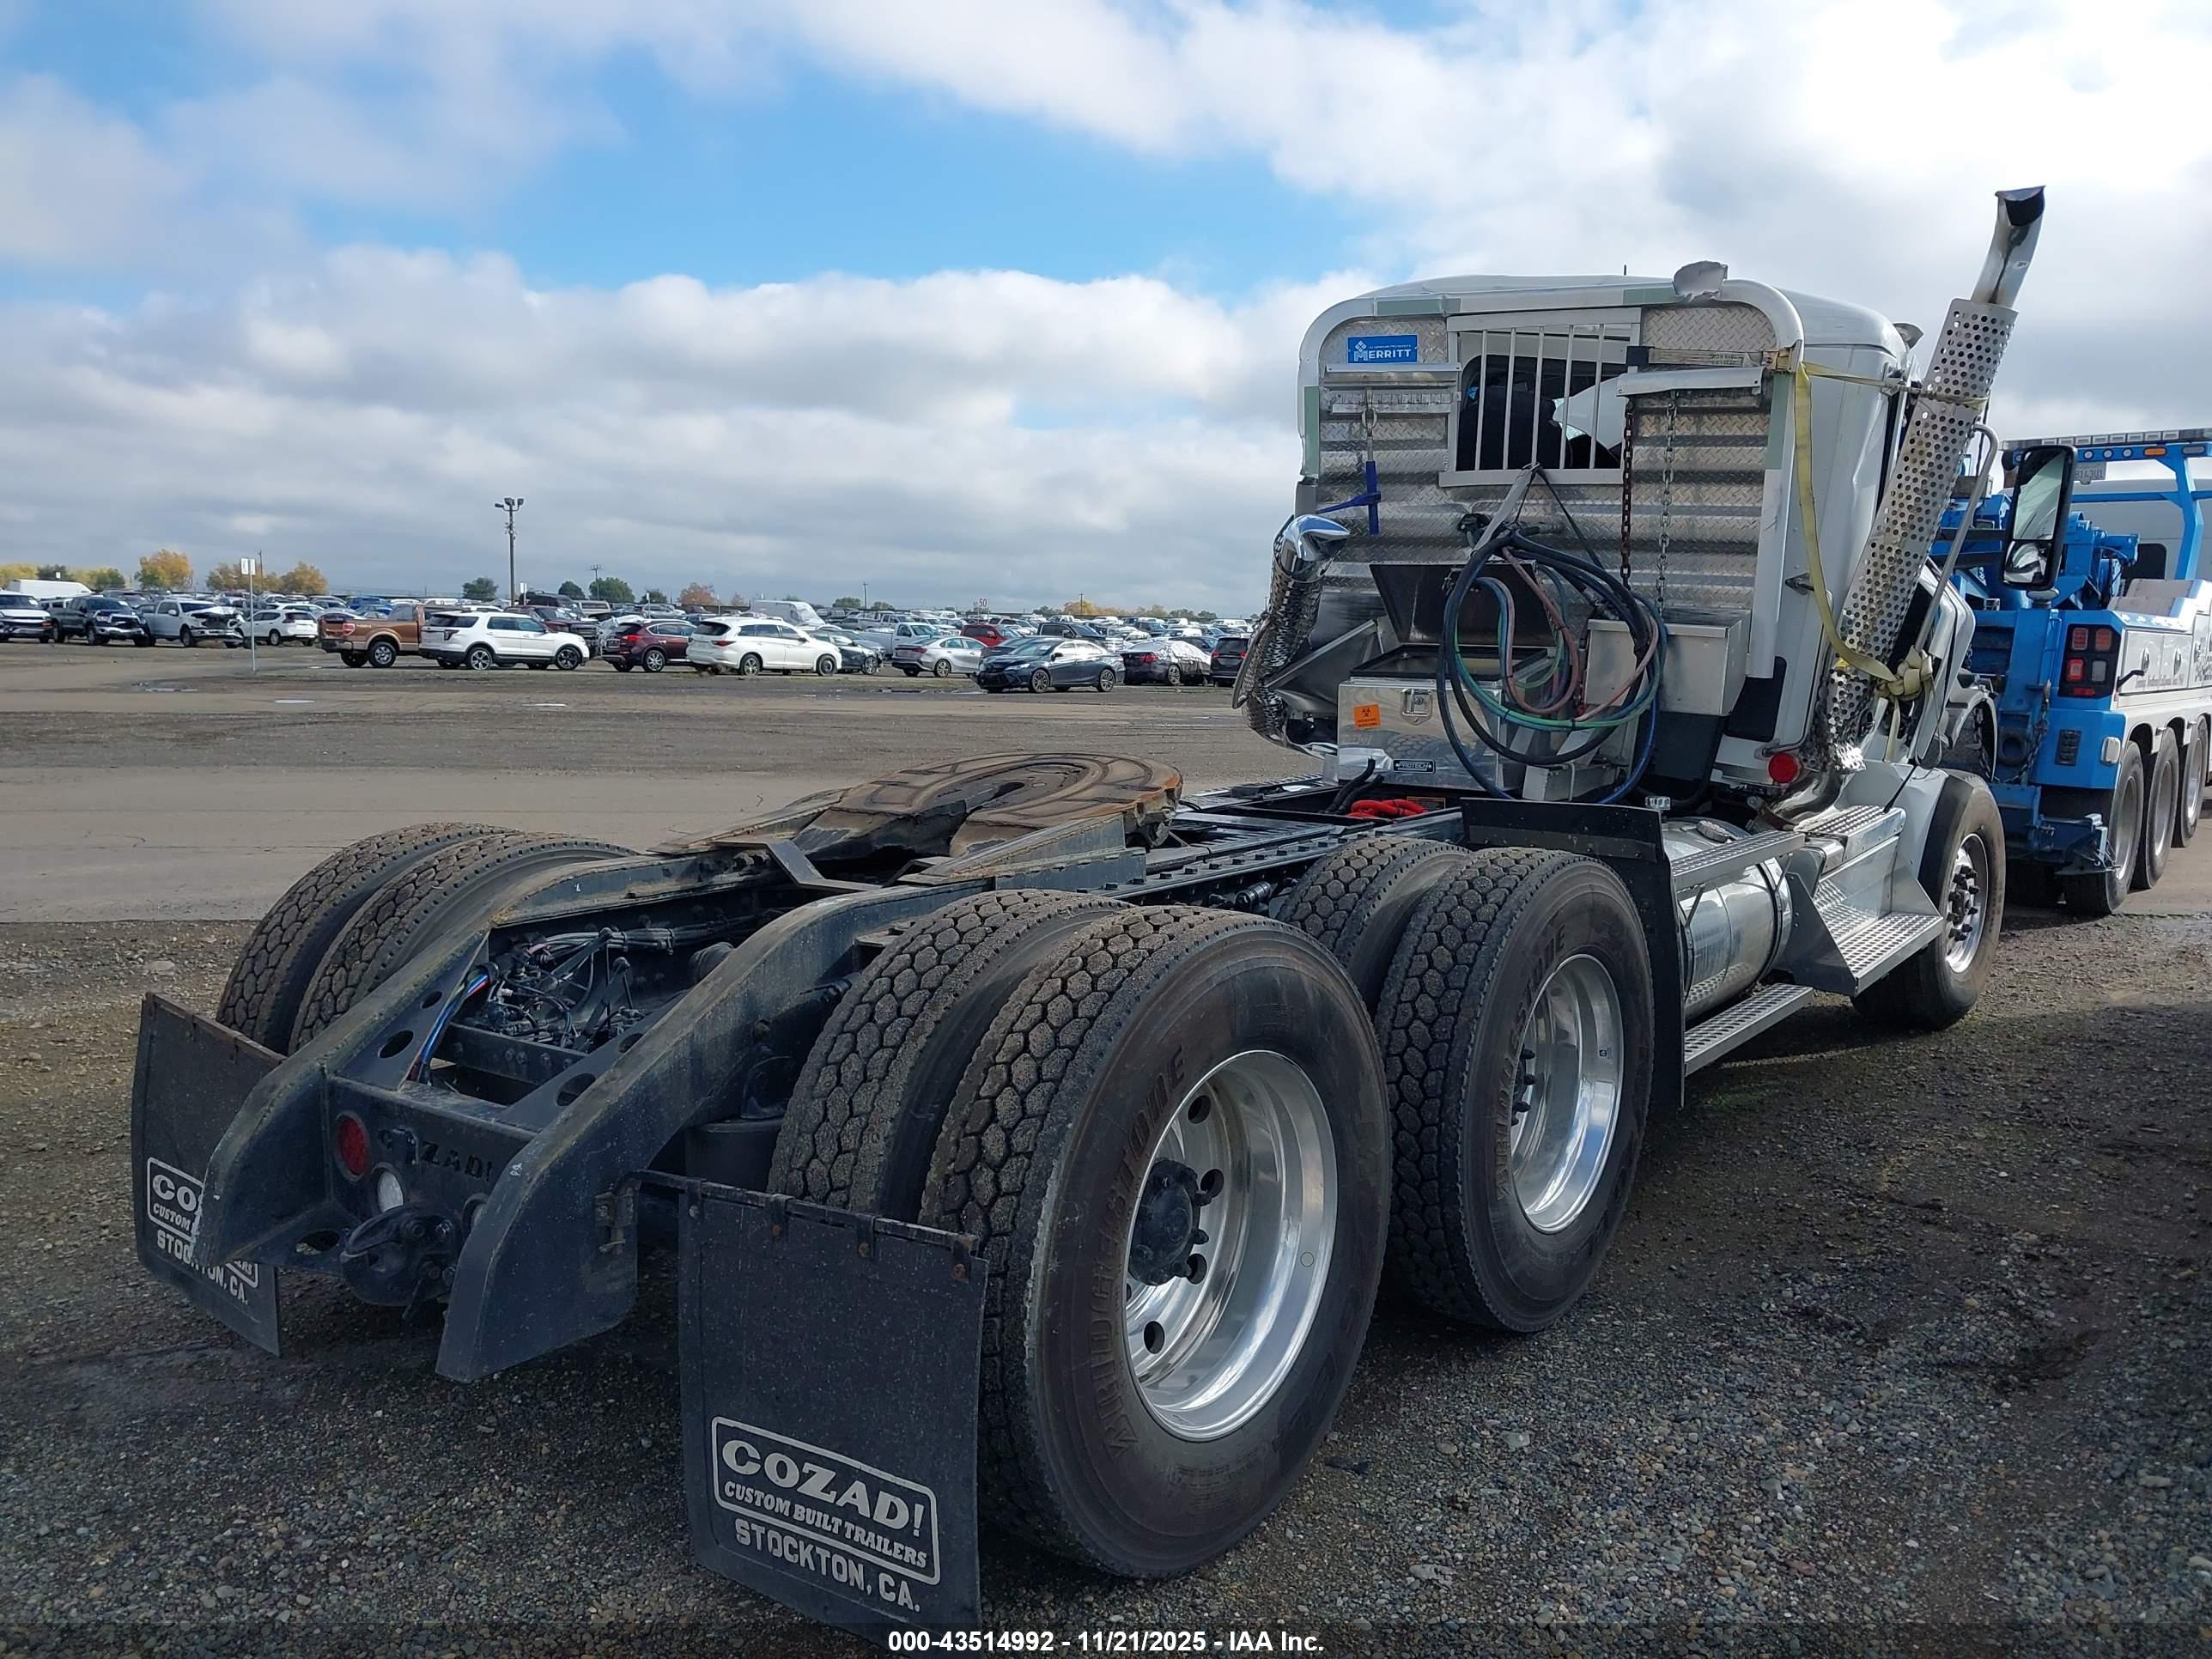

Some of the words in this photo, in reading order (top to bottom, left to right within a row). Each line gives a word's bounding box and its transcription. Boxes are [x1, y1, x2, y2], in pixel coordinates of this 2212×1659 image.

[1354, 349, 1411, 361] MERRITT
[979, 598, 988, 607] 50
[153, 1203, 191, 1231] CUSTOM
[230, 1275, 248, 1305] CA.
[722, 1440, 925, 1537] COZAD!
[724, 1481, 791, 1516] CUSTOM
[793, 1504, 842, 1534] BUILT
[845, 1522, 927, 1568] TRAILERS
[735, 1518, 872, 1595] STOCKTON,
[878, 1572, 921, 1613] CA.
